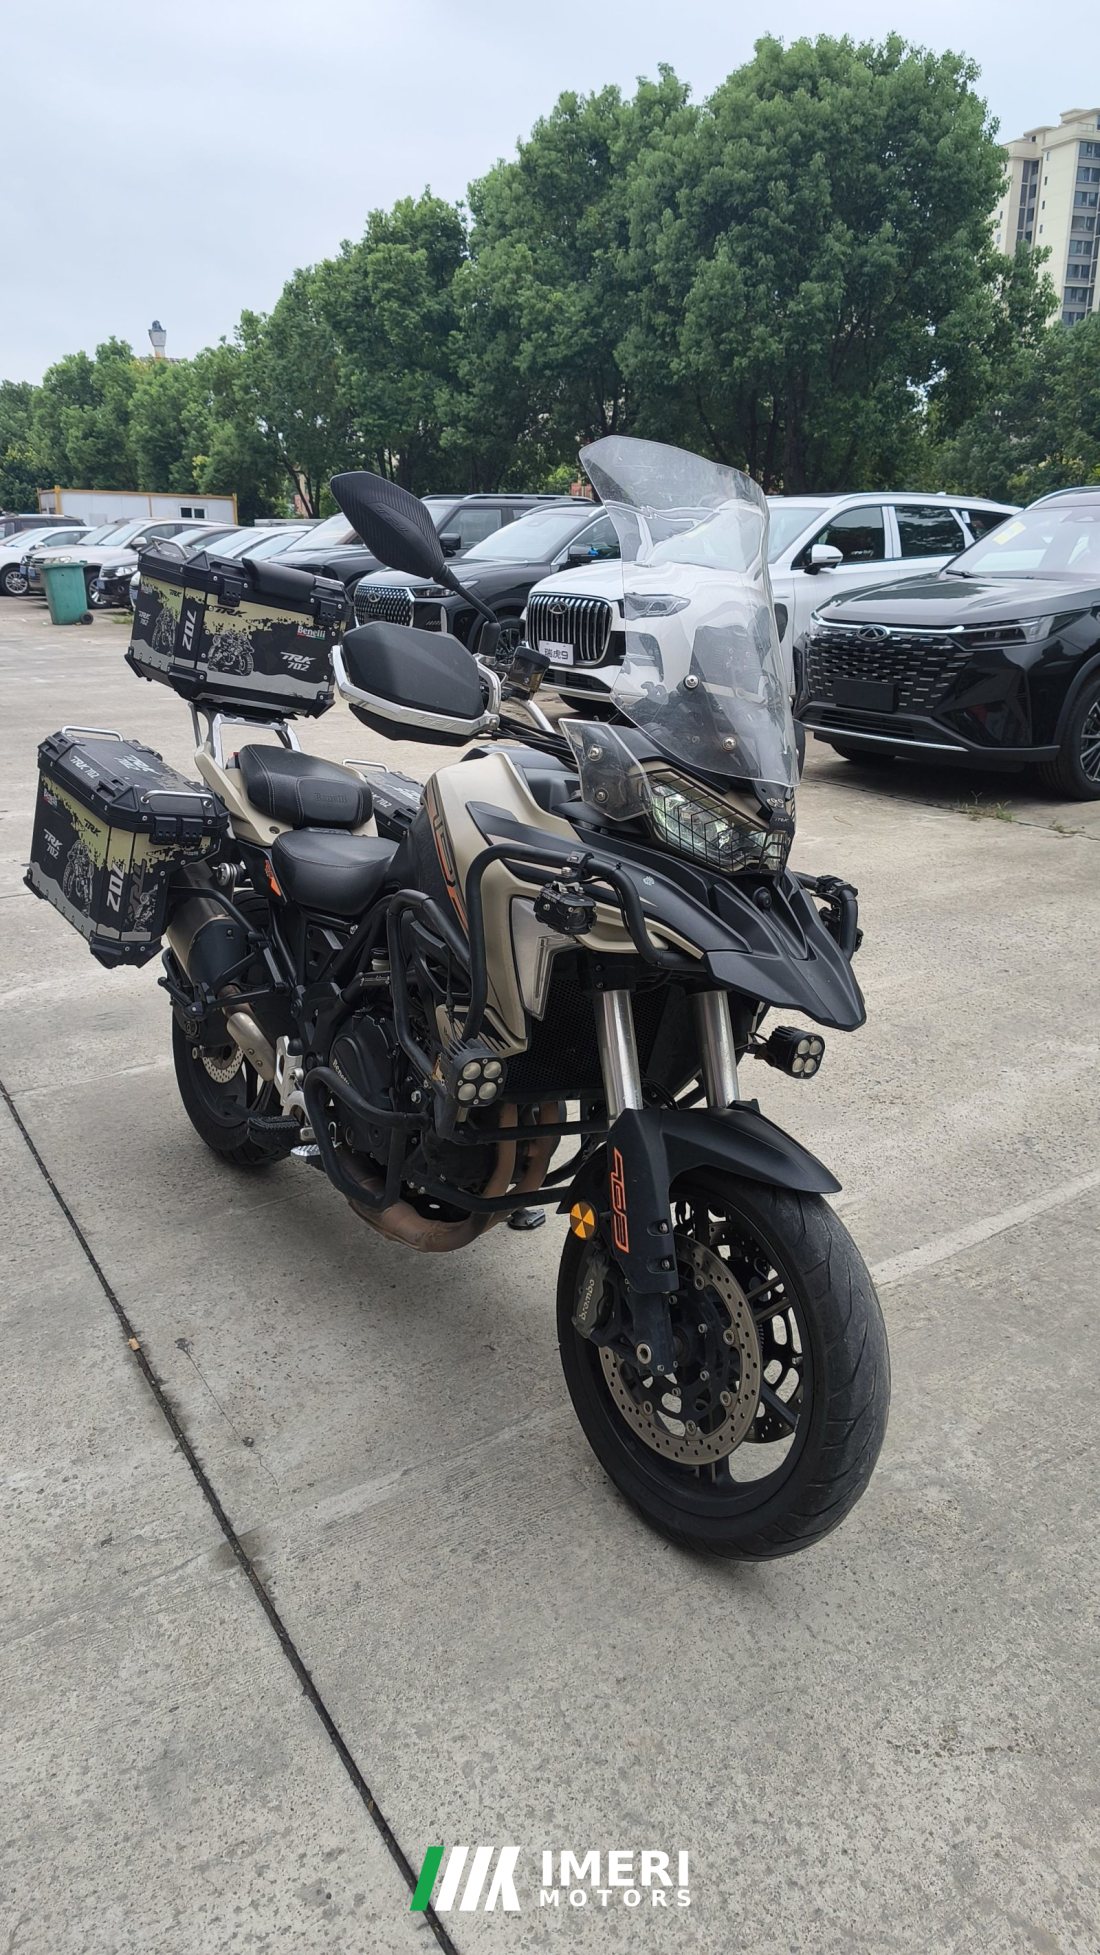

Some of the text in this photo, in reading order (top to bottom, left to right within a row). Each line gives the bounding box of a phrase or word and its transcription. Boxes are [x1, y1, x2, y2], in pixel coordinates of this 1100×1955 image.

[182, 610, 197, 651] 702
[298, 625, 326, 638] Benelli
[280, 651, 317, 665] TRK
[287, 661, 310, 672] 702
[70, 755, 100, 779] TRK 702
[83, 818, 102, 837] TRK
[43, 828, 63, 850] TRK
[46, 842, 60, 859] 702
[106, 862, 126, 913] 702
[579, 1279, 595, 1321] brembo
